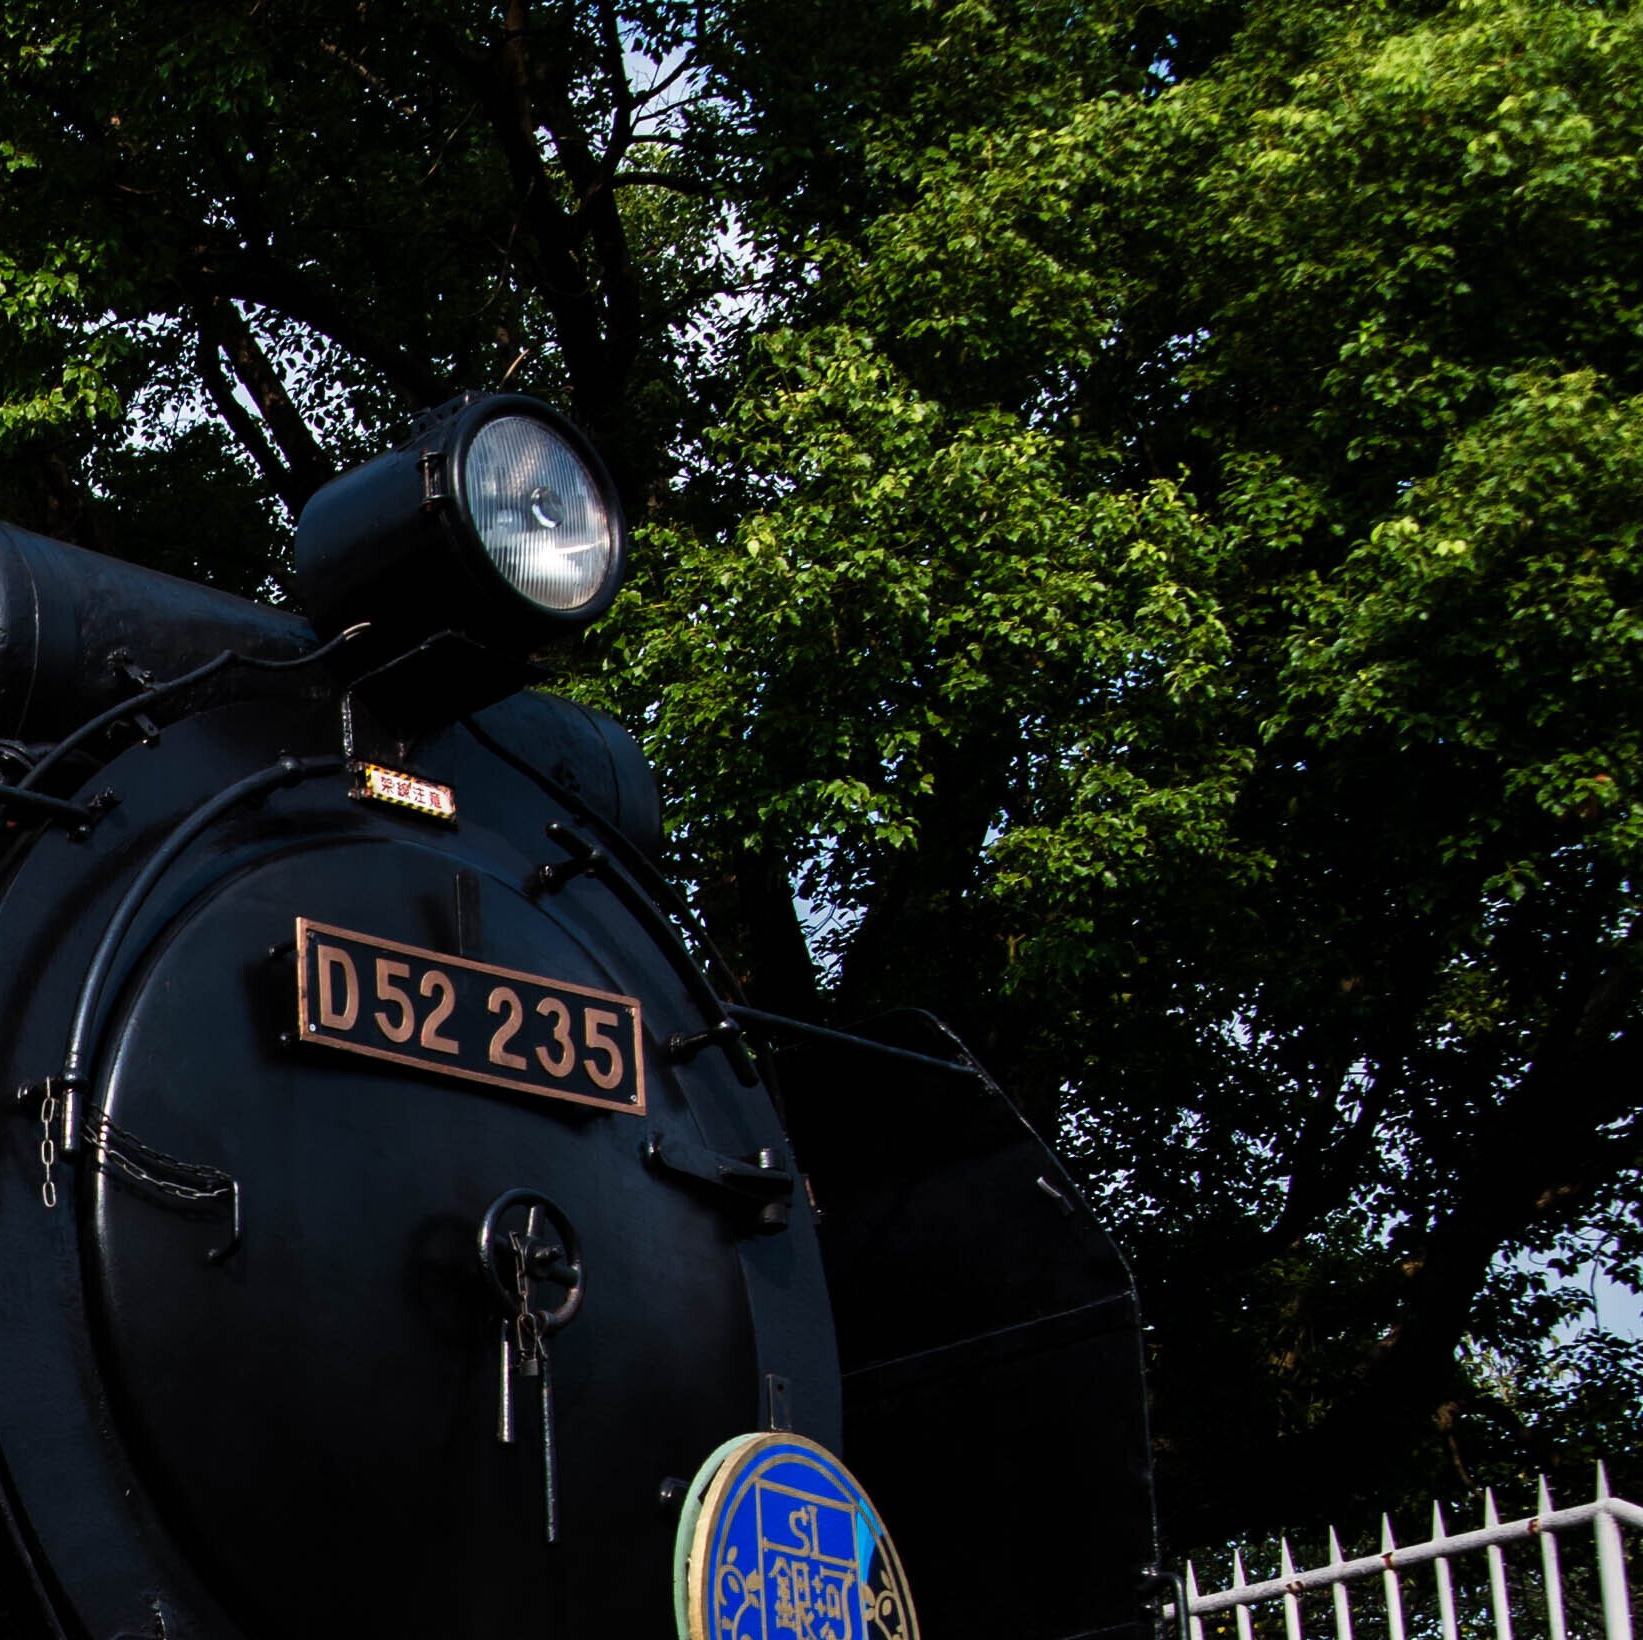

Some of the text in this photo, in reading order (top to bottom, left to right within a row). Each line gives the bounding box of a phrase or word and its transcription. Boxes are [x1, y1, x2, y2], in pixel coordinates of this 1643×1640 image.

[381, 776, 442, 808] 架線注意
[487, 985, 624, 1090] 235
[764, 1504, 857, 1569] SL
